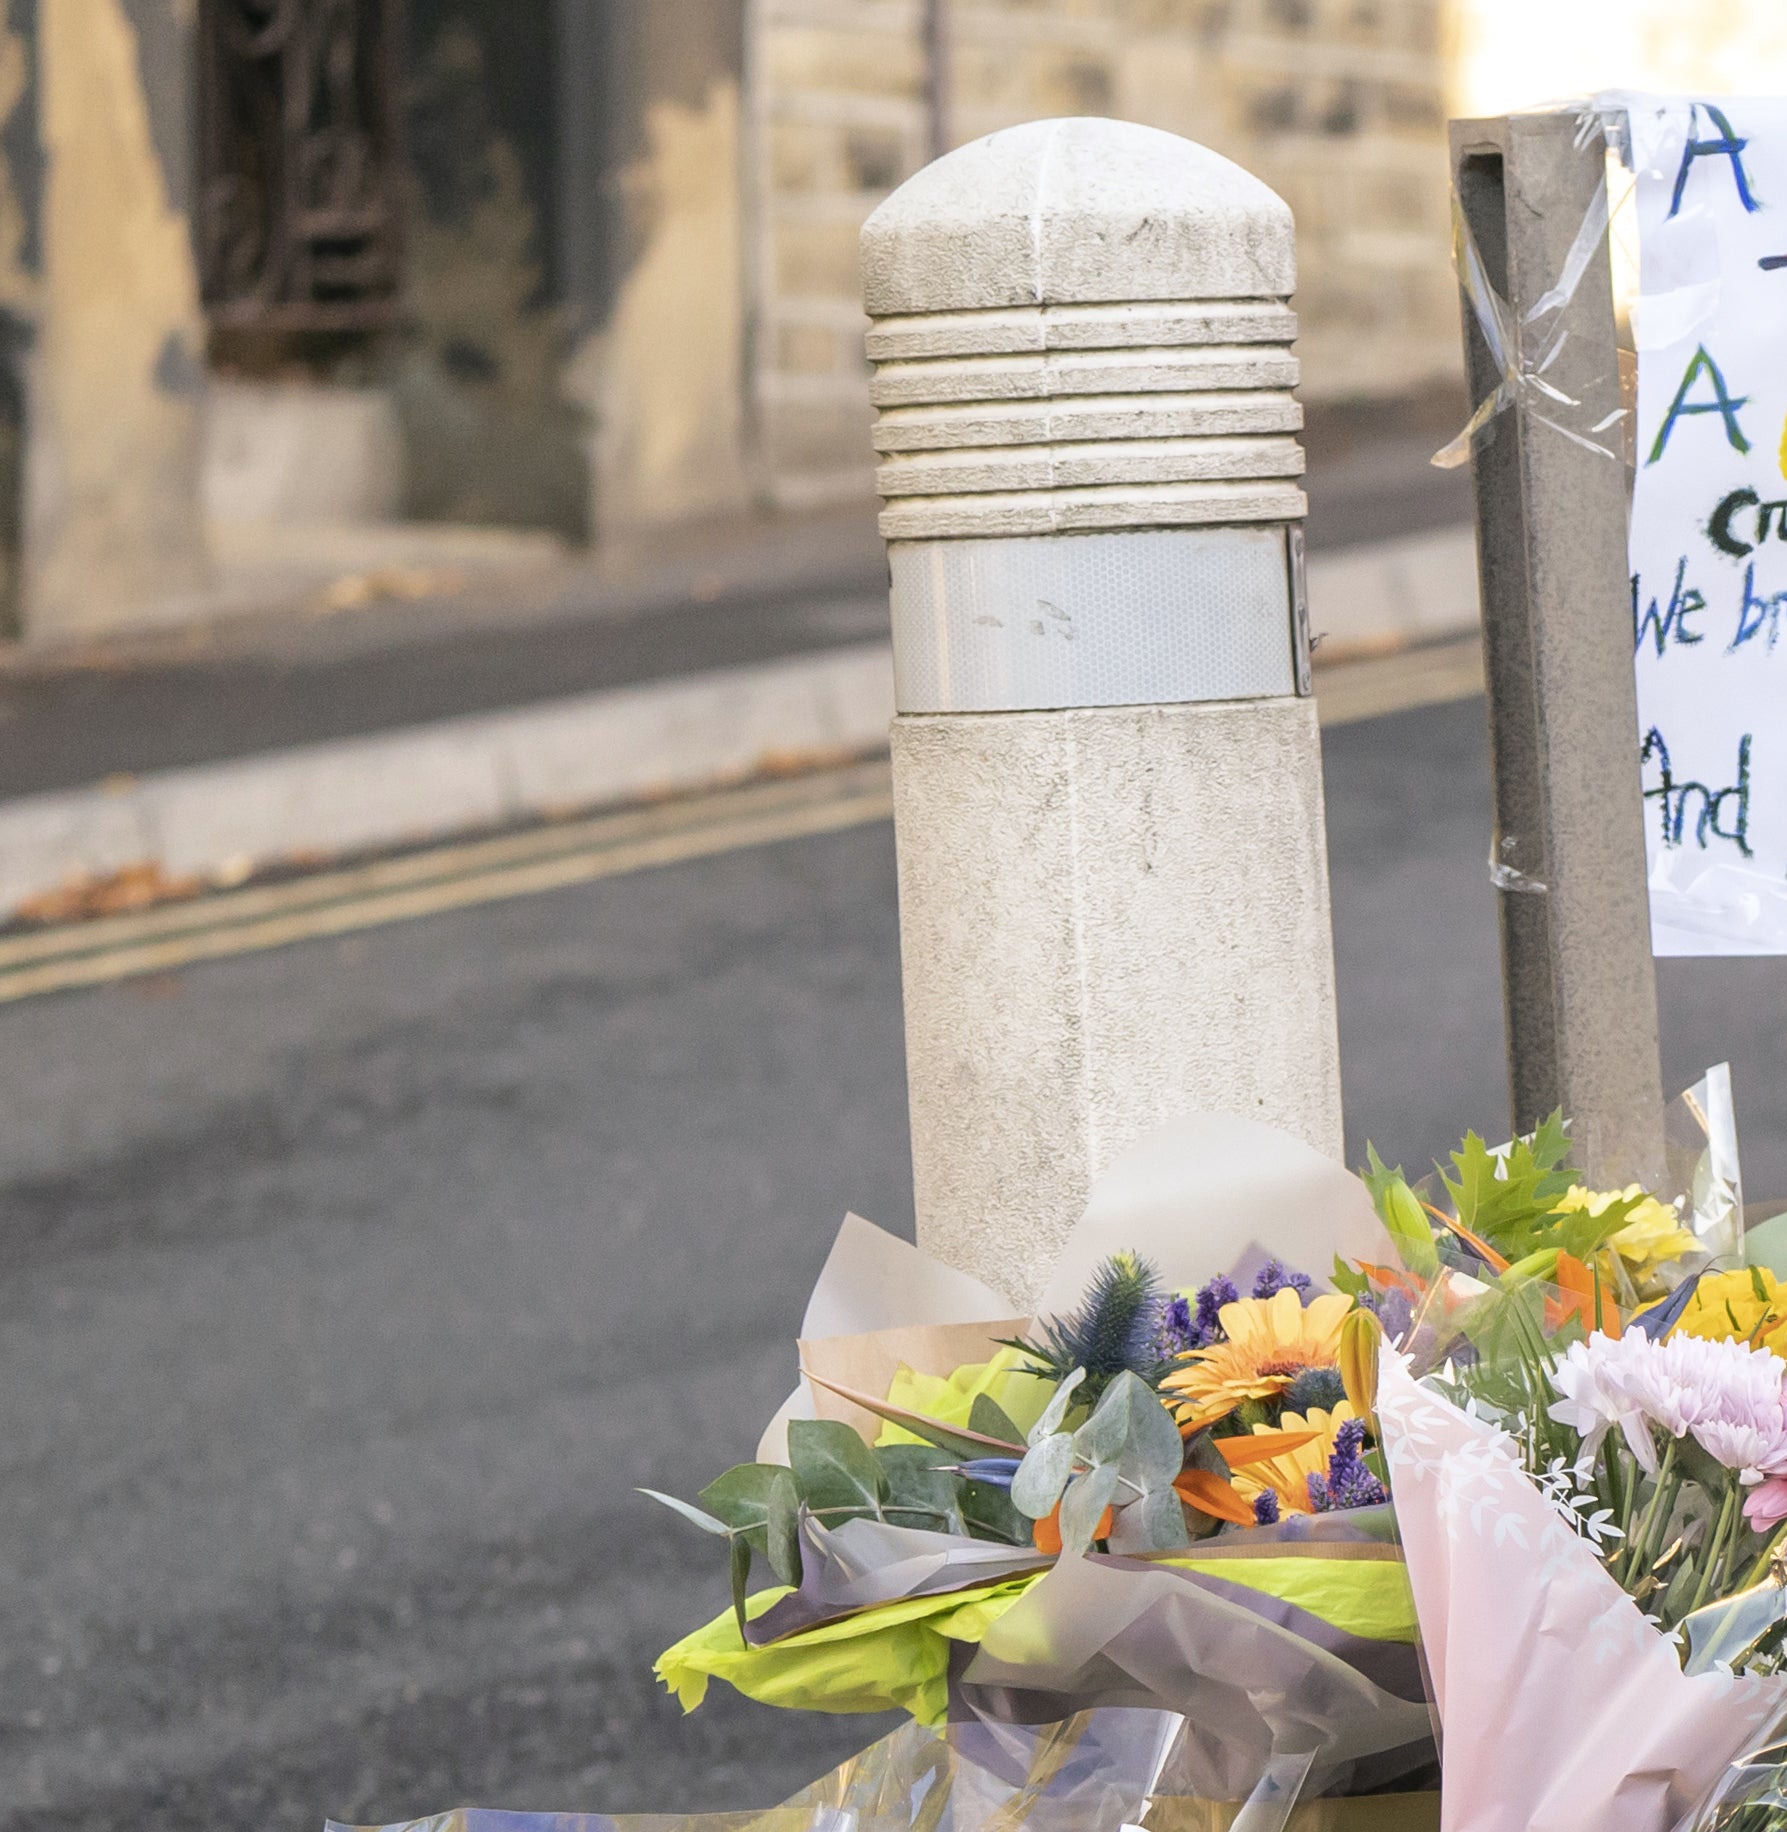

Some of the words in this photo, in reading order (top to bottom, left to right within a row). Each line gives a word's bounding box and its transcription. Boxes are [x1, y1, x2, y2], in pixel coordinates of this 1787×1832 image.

[1664, 102, 1764, 221] A
[1644, 342, 1754, 468] A
[1630, 555, 1707, 658] We
